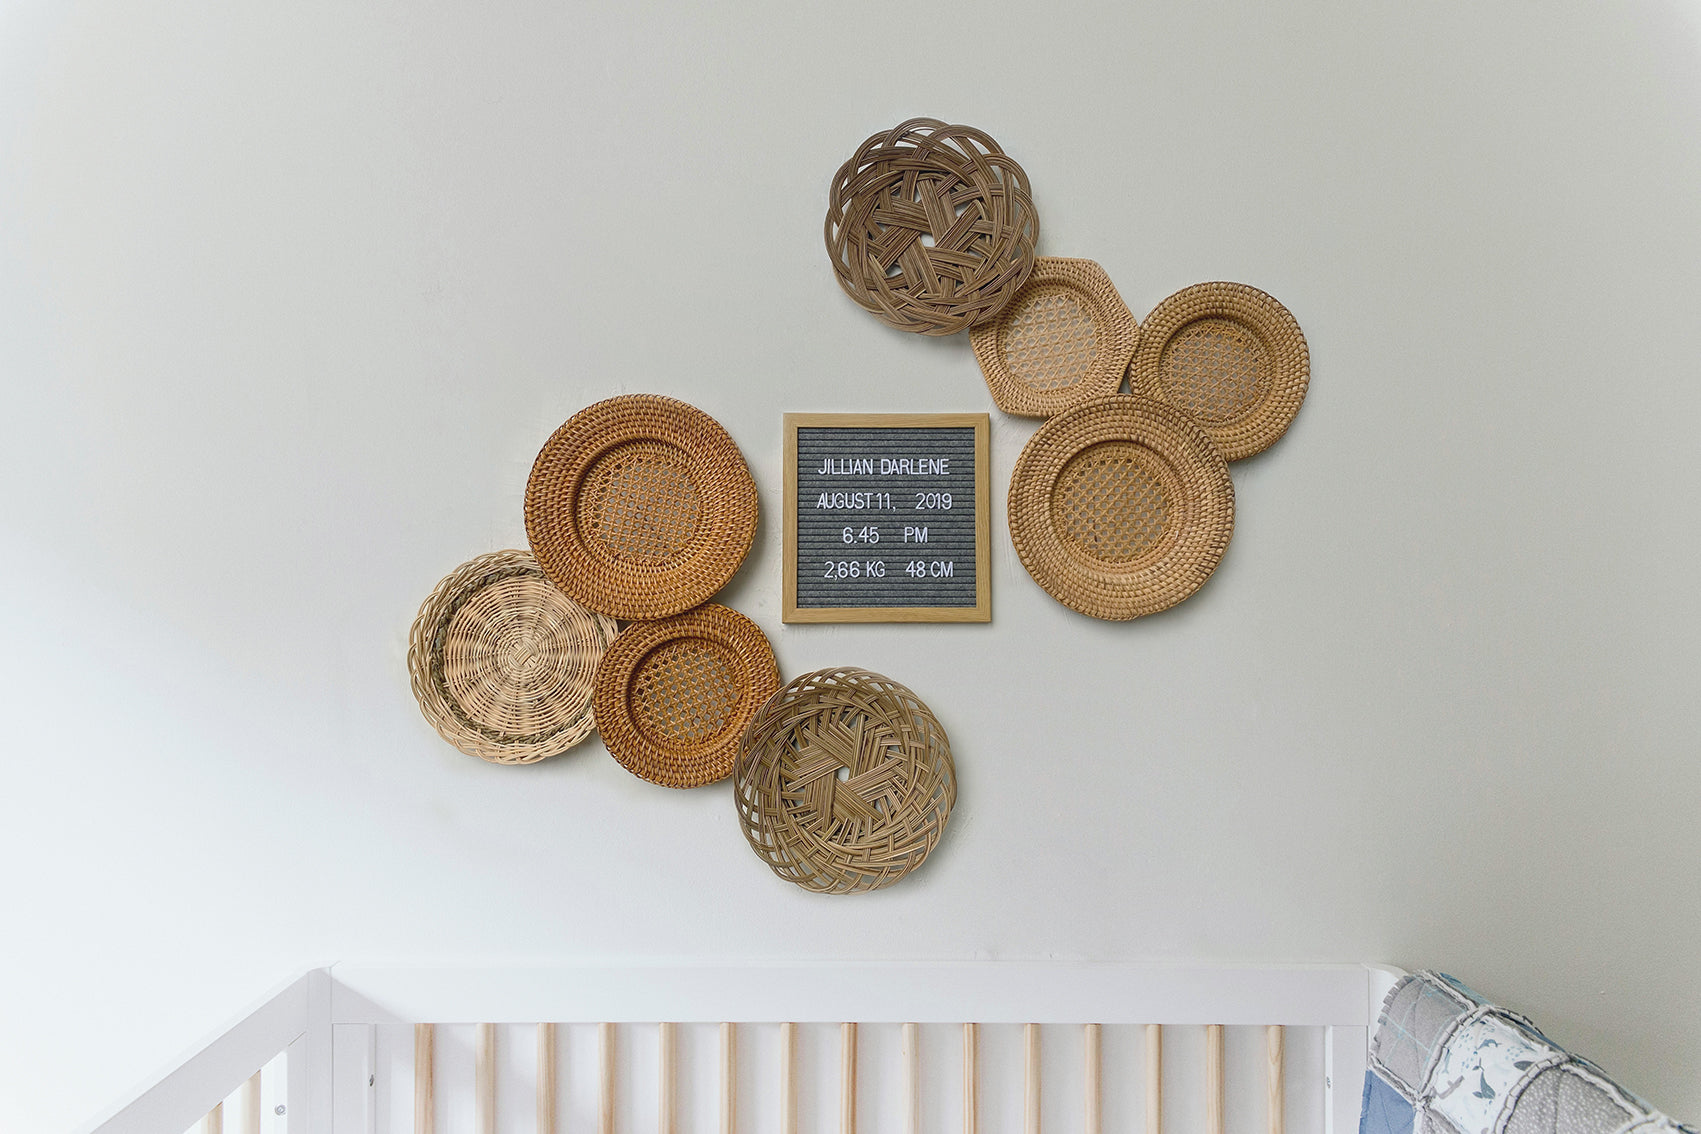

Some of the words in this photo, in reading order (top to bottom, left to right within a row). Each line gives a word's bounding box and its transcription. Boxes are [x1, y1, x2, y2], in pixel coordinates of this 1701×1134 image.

[817, 458, 874, 475] JILLIAN
[880, 458, 950, 475] DARLENE
[915, 492, 953, 510] 2019
[842, 526, 880, 544] 6.45
[904, 526, 928, 543] PM
[824, 560, 860, 581] 2,66
[866, 560, 885, 578] KG
[905, 560, 926, 578] 48
[930, 560, 954, 578] CM
